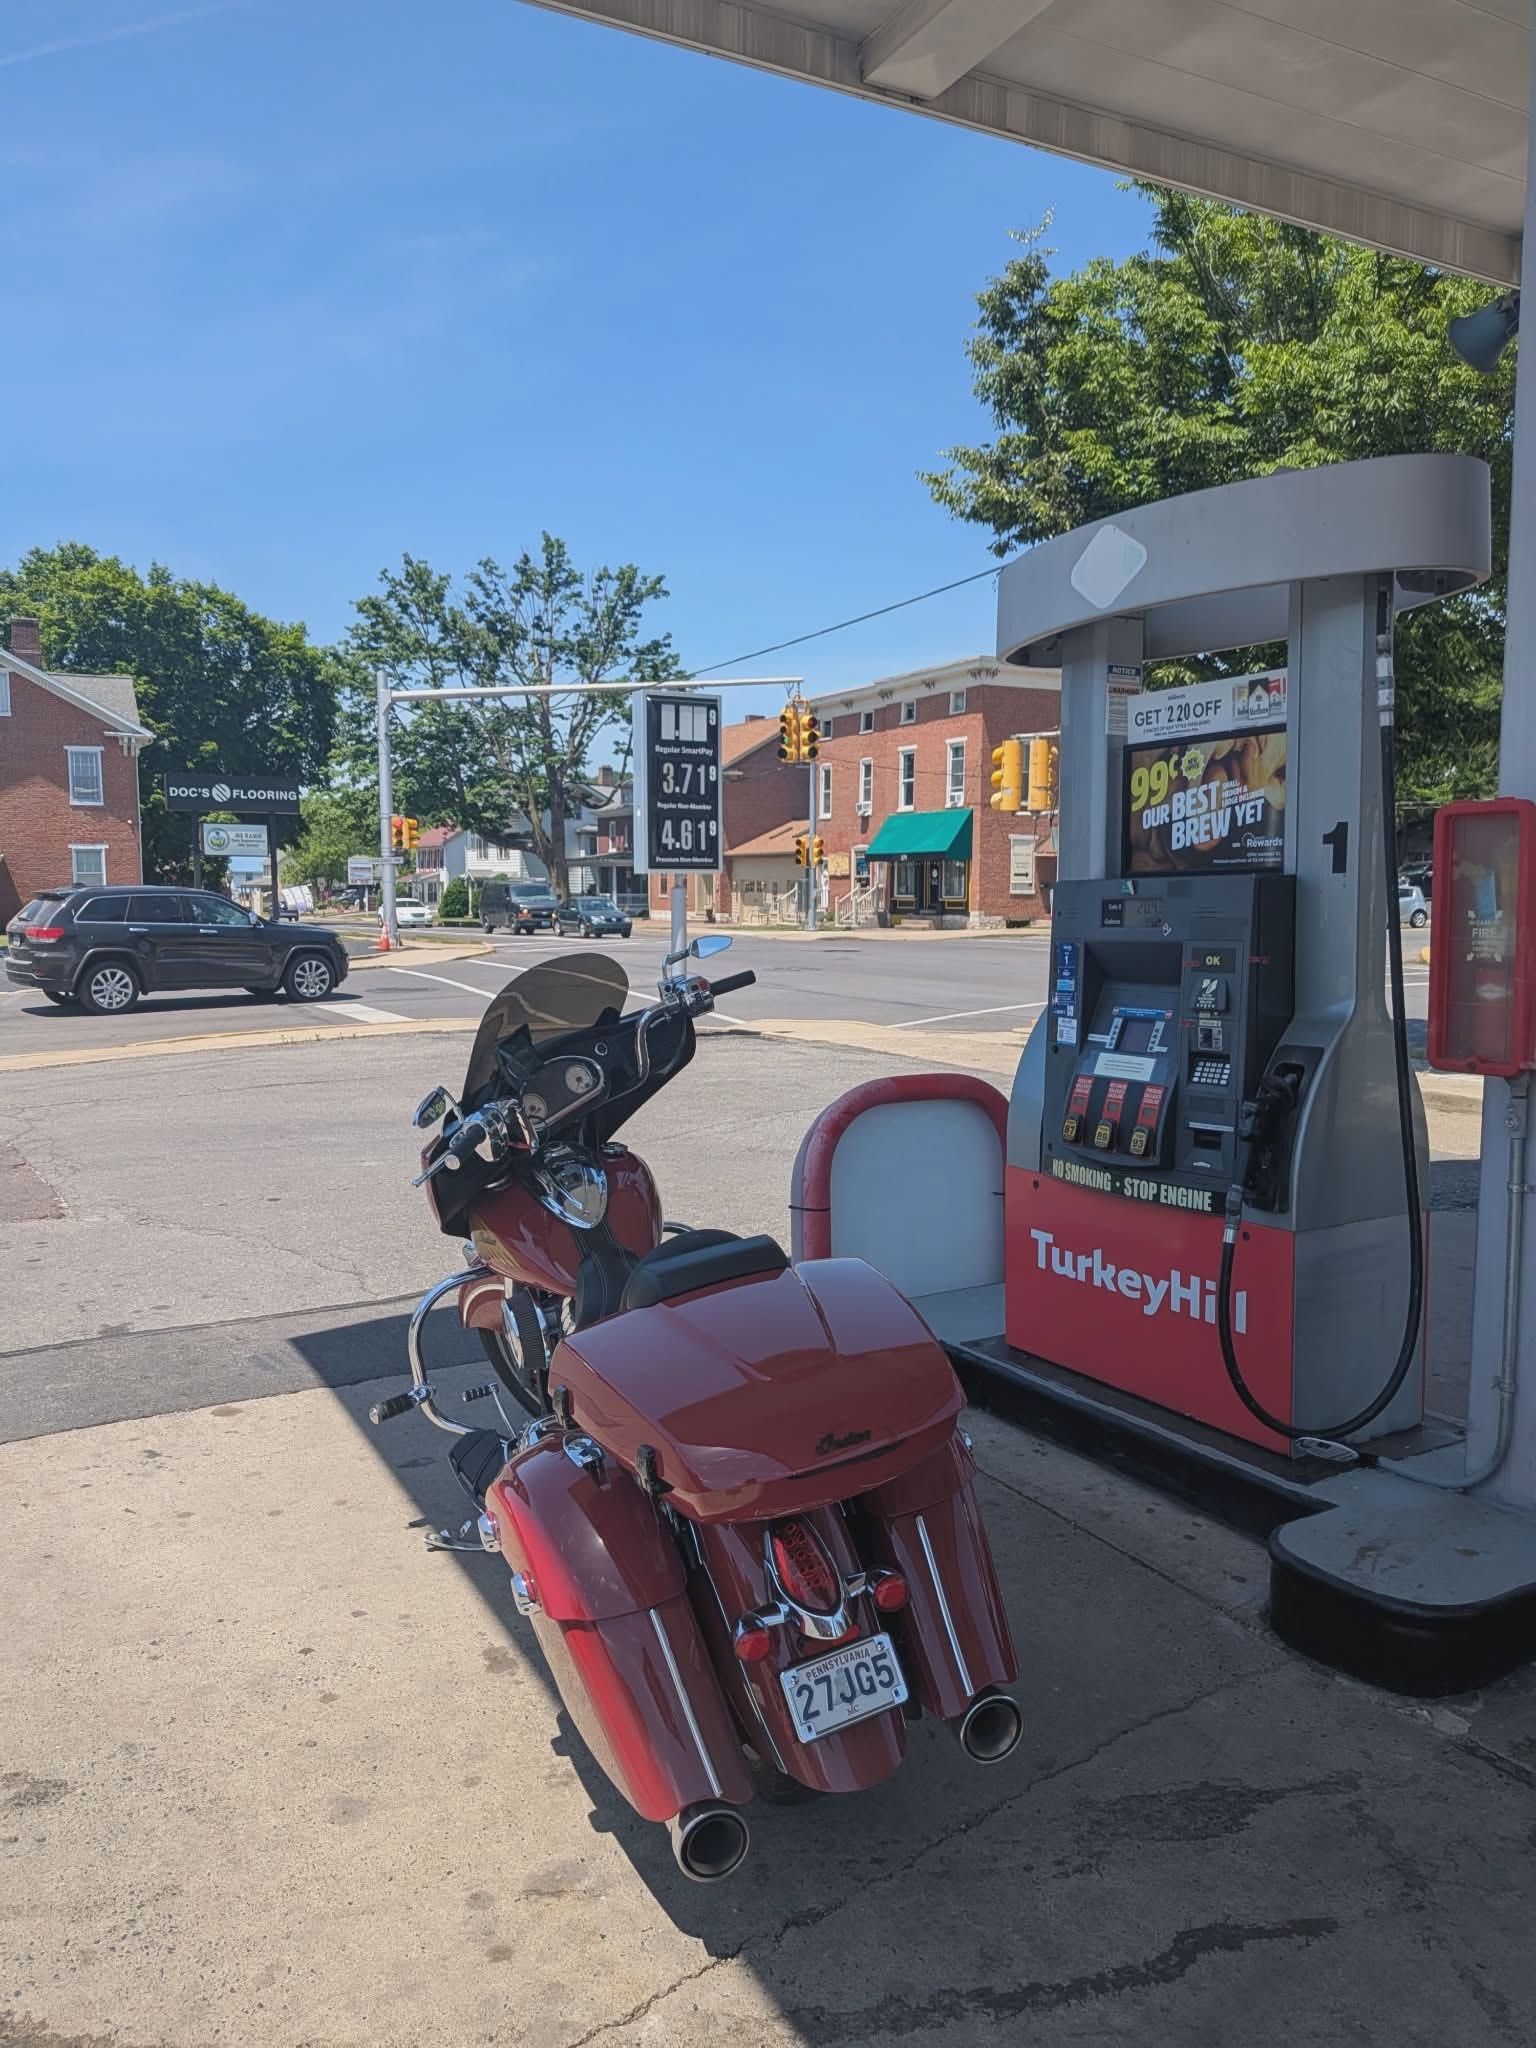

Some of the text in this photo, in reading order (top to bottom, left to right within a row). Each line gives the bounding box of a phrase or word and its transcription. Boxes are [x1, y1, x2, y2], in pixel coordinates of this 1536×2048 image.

[1134, 709, 1162, 727] GET
[1193, 699, 1222, 718] OFF
[655, 745, 713, 757] Regular SmartPay
[169, 786, 297, 801] DOC'S FLOORING
[1142, 781, 1220, 829] OUR BEST
[1171, 798, 1265, 850] BREW YET
[1246, 836, 1283, 849] Rewards
[1323, 822, 1348, 873] 1
[1472, 928, 1497, 937] FIRE
[1206, 956, 1221, 966] OK
[1064, 1125, 1075, 1135] 87
[1096, 1131, 1107, 1140] 89
[1132, 1139, 1143, 1148] 93
[1052, 1158, 1212, 1212] NO SMOKING STOP ENGINE
[1030, 1227, 1247, 1334] TurkeyHil
[806, 1647, 870, 1681] PENNSYLVANIA
[796, 1653, 895, 1722] 27JG5
